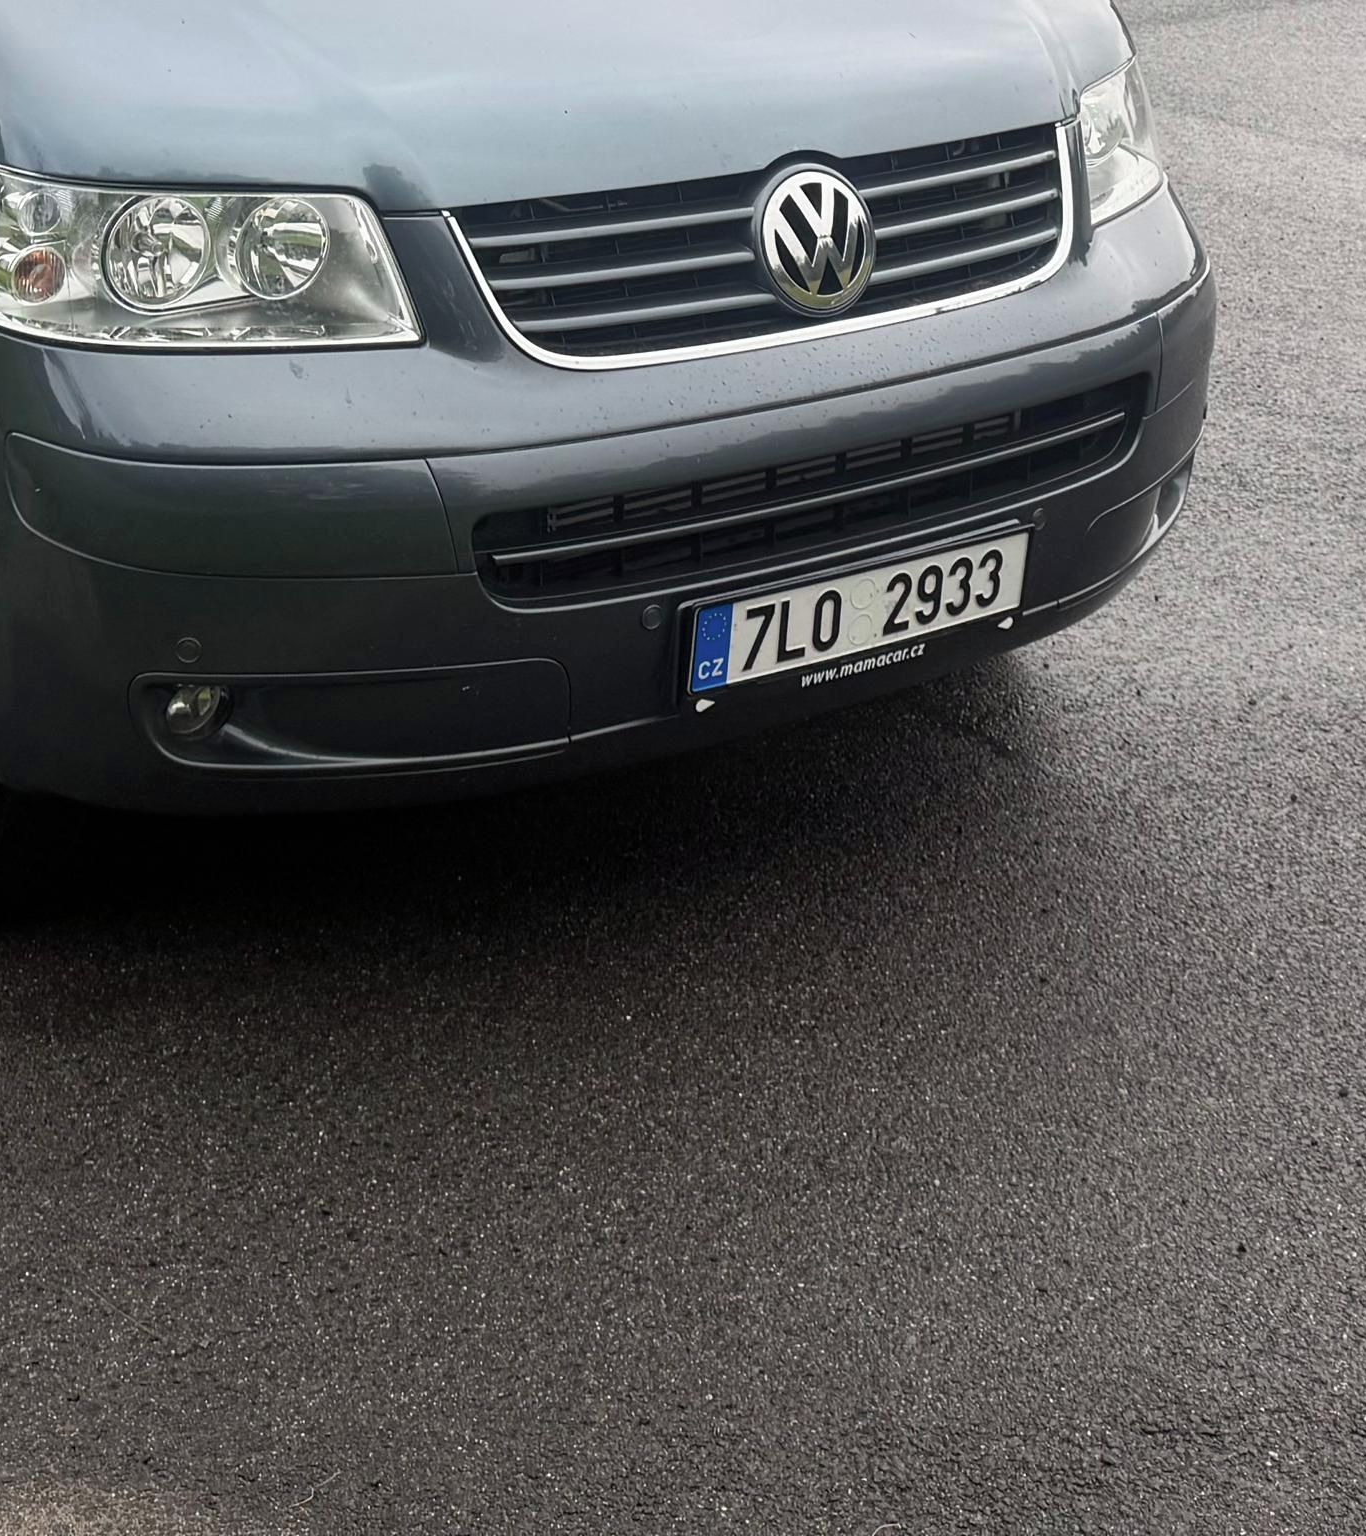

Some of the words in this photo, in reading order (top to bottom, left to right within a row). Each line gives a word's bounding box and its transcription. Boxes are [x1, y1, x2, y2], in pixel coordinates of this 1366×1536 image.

[881, 547, 1004, 638] 2933
[697, 657, 725, 681] CZ
[800, 643, 926, 688] www.mamacar.cz
